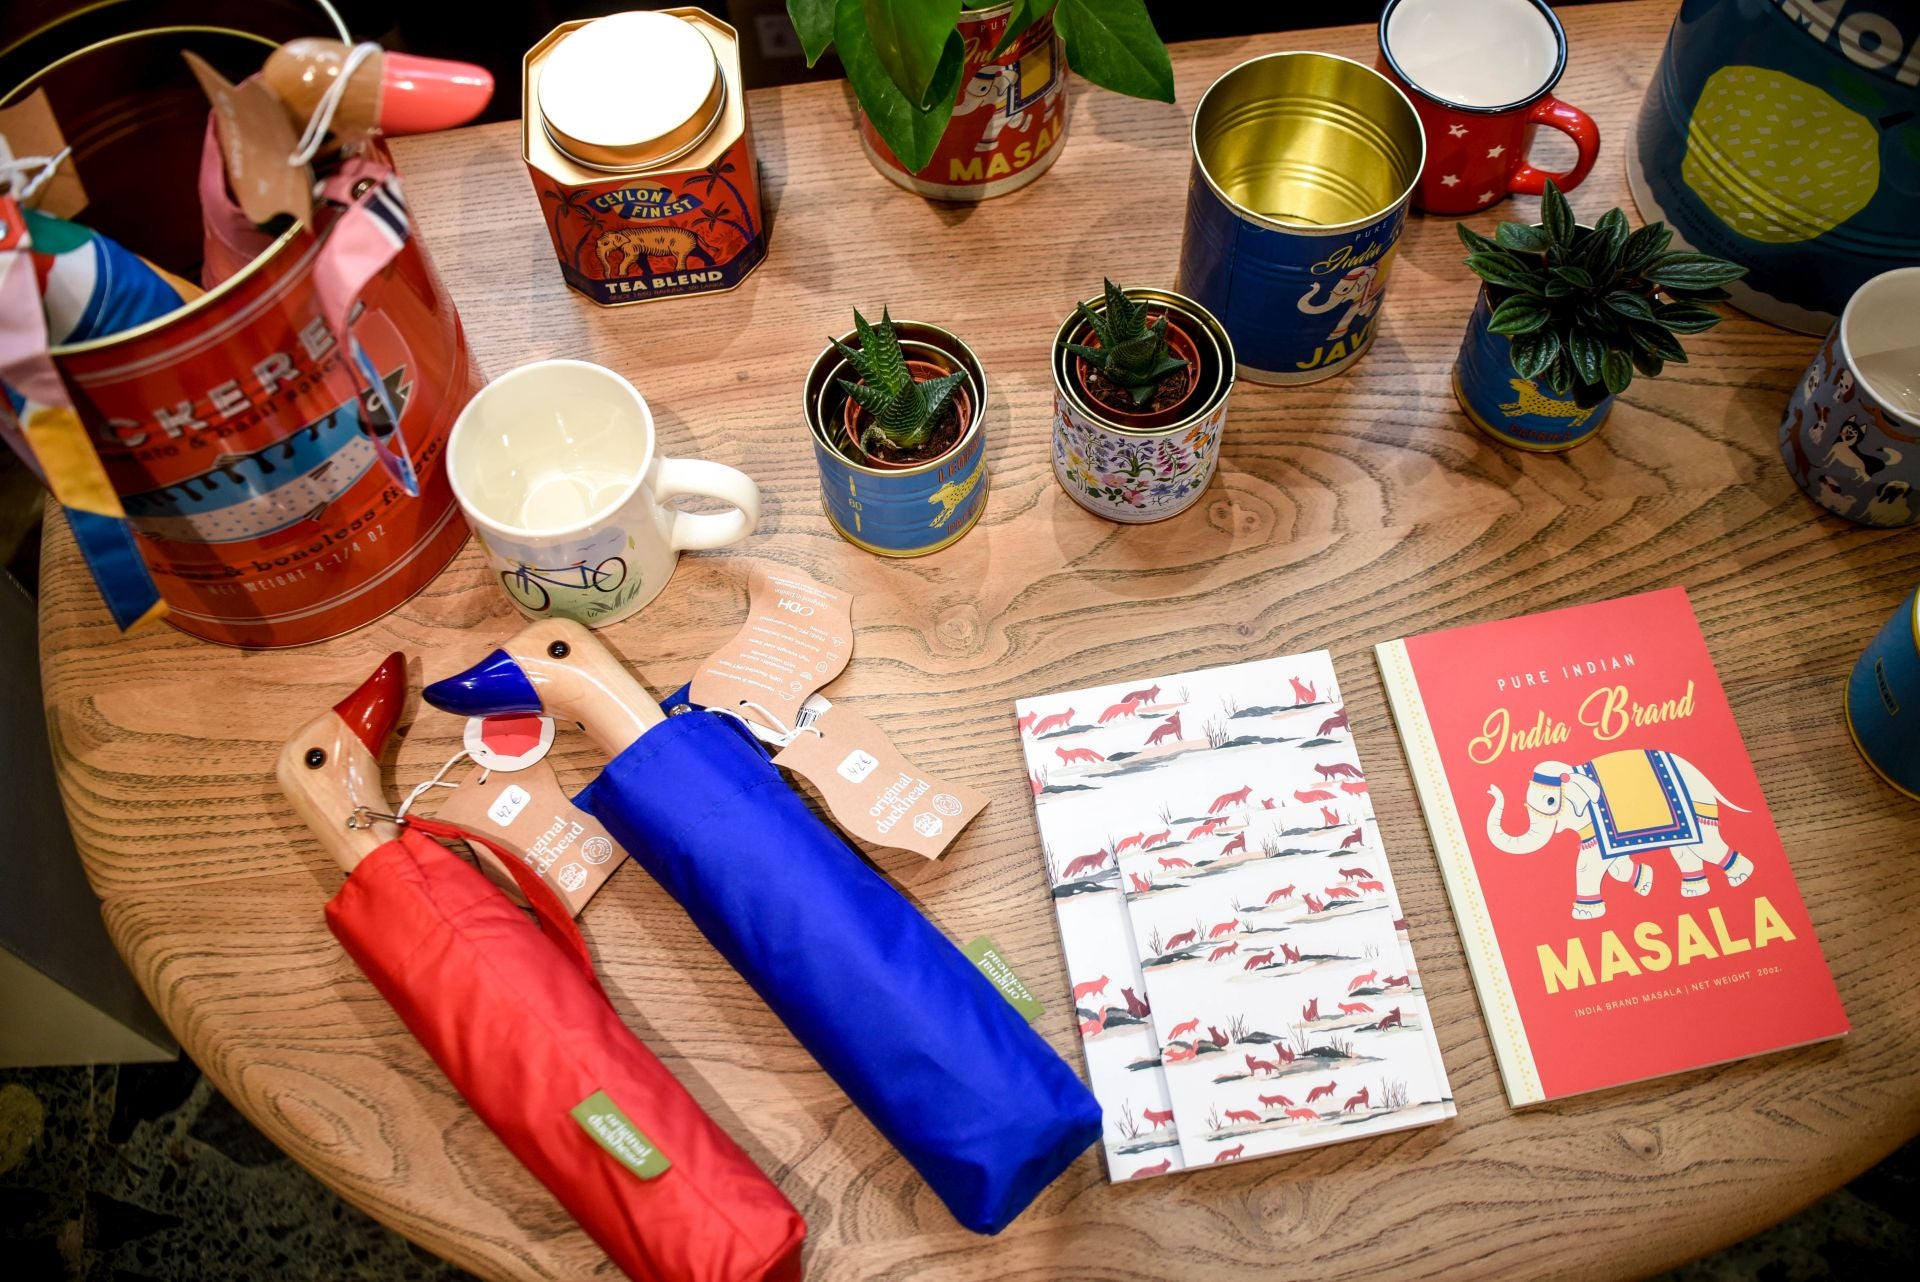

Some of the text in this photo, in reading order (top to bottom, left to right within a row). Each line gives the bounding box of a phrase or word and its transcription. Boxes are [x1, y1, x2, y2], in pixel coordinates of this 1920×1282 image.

[980, 18, 1008, 33] PUR
[950, 115, 1063, 182] MASAL
[594, 188, 664, 209] CEYLON
[631, 199, 694, 219] FINEST
[1355, 220, 1389, 241] PURE
[1310, 241, 1383, 276] India
[604, 280, 648, 295] TEA
[652, 270, 724, 290] BLEND
[108, 299, 366, 448] CKERE
[243, 569, 307, 593] WEIGHT
[314, 542, 361, 572] 4-1/4
[367, 523, 386, 543] OZ
[777, 597, 815, 617] ODH
[1497, 652, 1637, 692] PURE INDIAN
[1467, 679, 1696, 765] India Brand
[868, 771, 914, 818] original
[876, 778, 931, 834] duckhead
[524, 815, 569, 866] riginal
[534, 820, 585, 878] ckhead
[1535, 895, 1797, 995] MASALA
[977, 958, 1020, 1000] original
[983, 949, 1033, 1002] duckhead
[1574, 1004, 1603, 1018] INDIA
[1605, 996, 1639, 1011] BRAND
[1642, 986, 1683, 1003] MASALA
[1691, 980, 1710, 992] NET
[1713, 971, 1752, 987] WEIGHT
